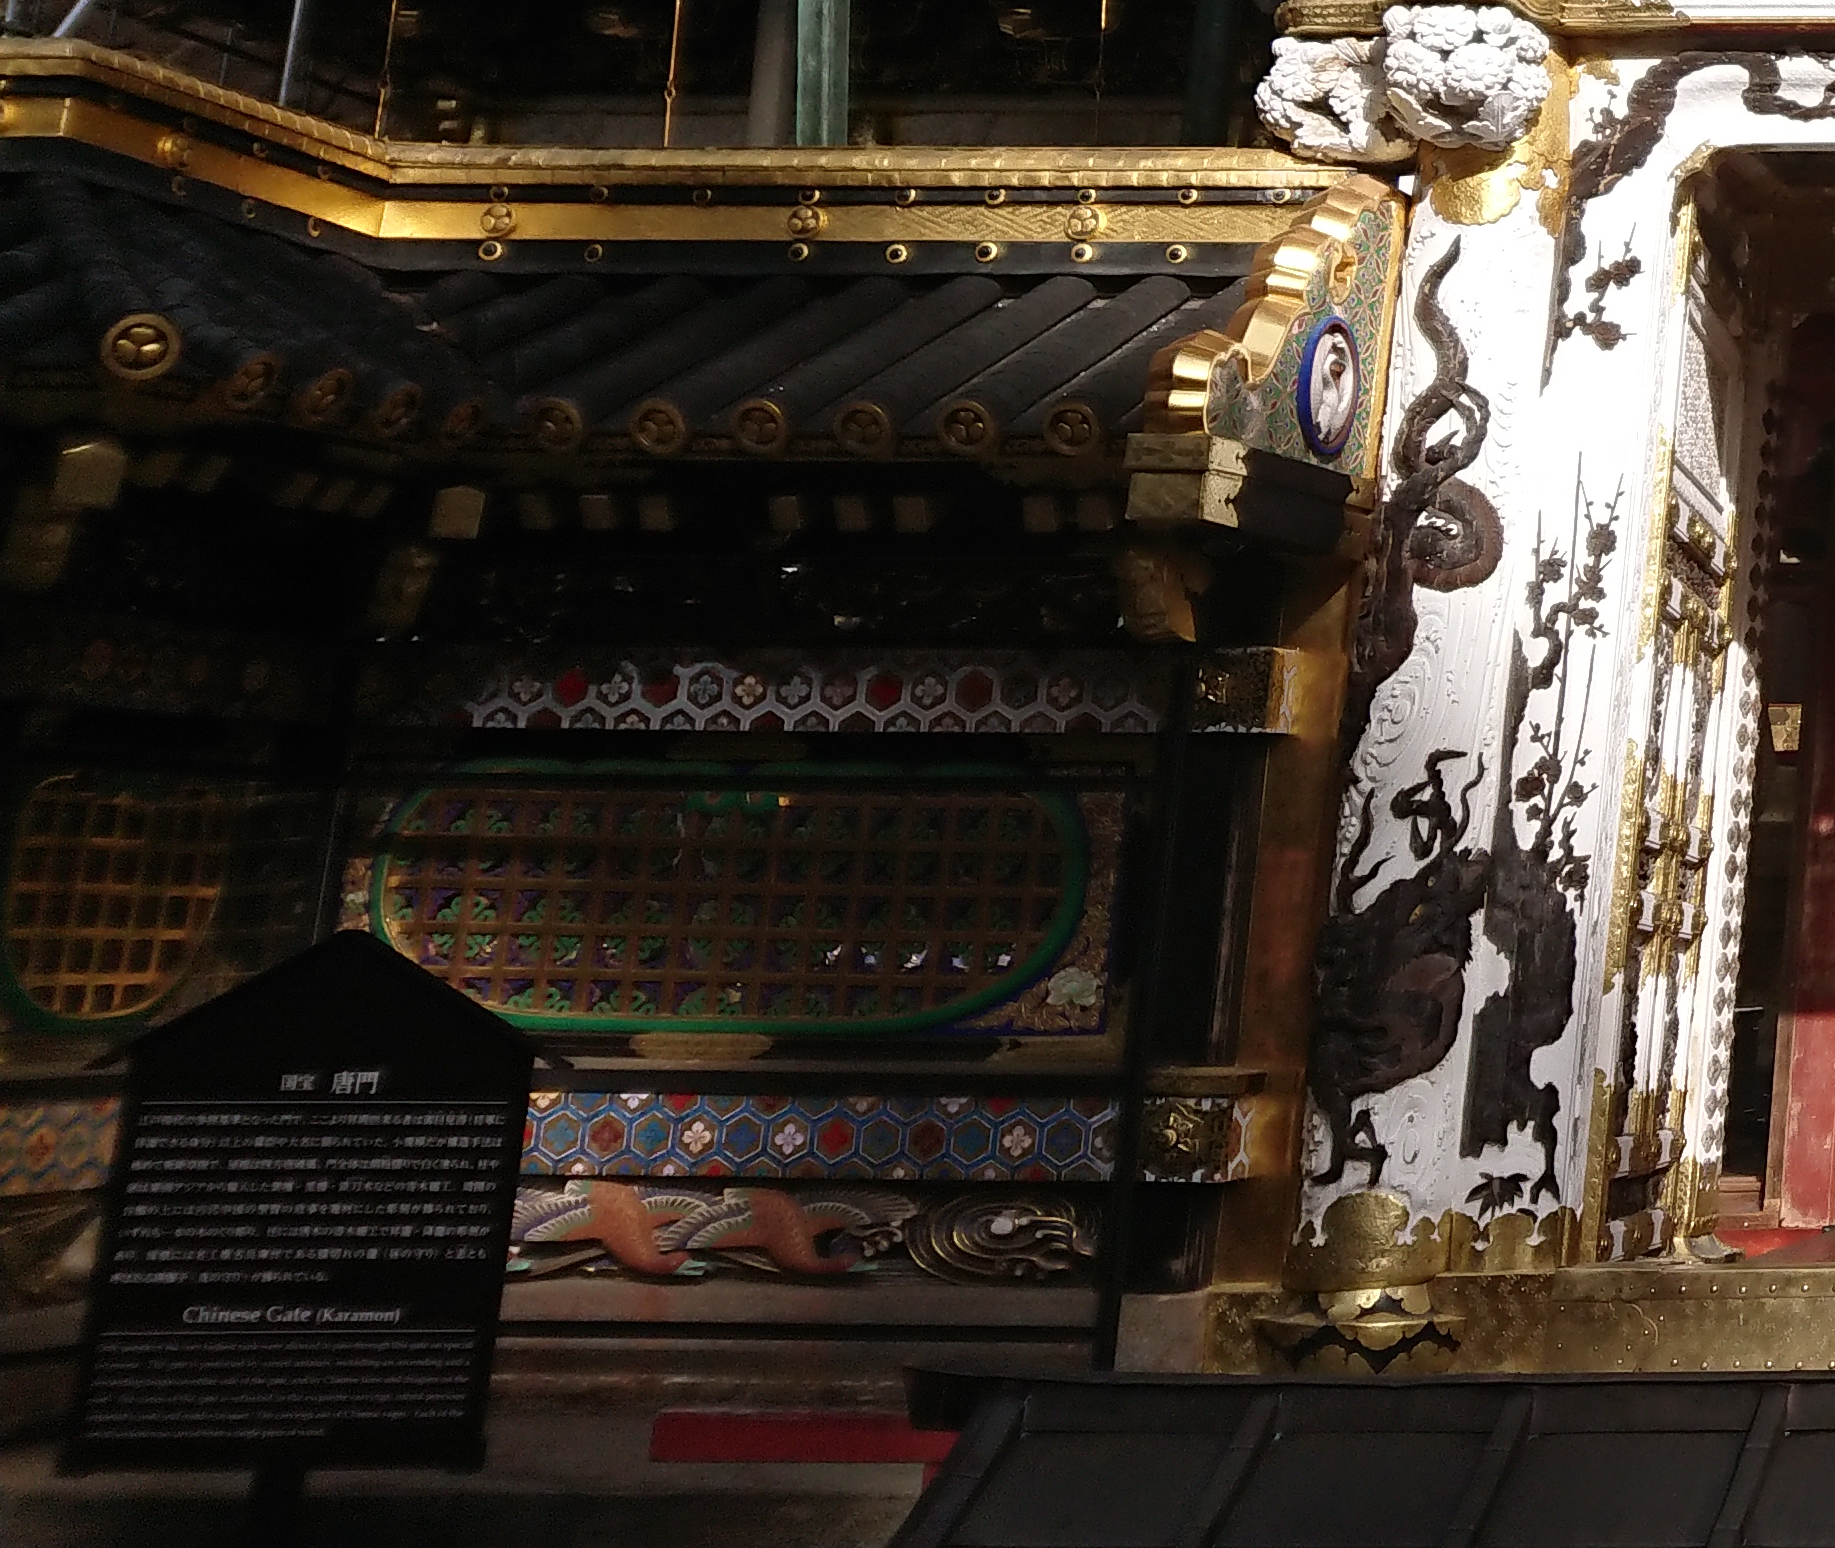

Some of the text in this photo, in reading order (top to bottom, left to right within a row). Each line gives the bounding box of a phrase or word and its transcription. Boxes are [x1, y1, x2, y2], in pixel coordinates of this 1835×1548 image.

[280, 1070, 380, 1095] 国宝 唐門
[182, 1305, 401, 1325] Chinese Gate (Karamon)
